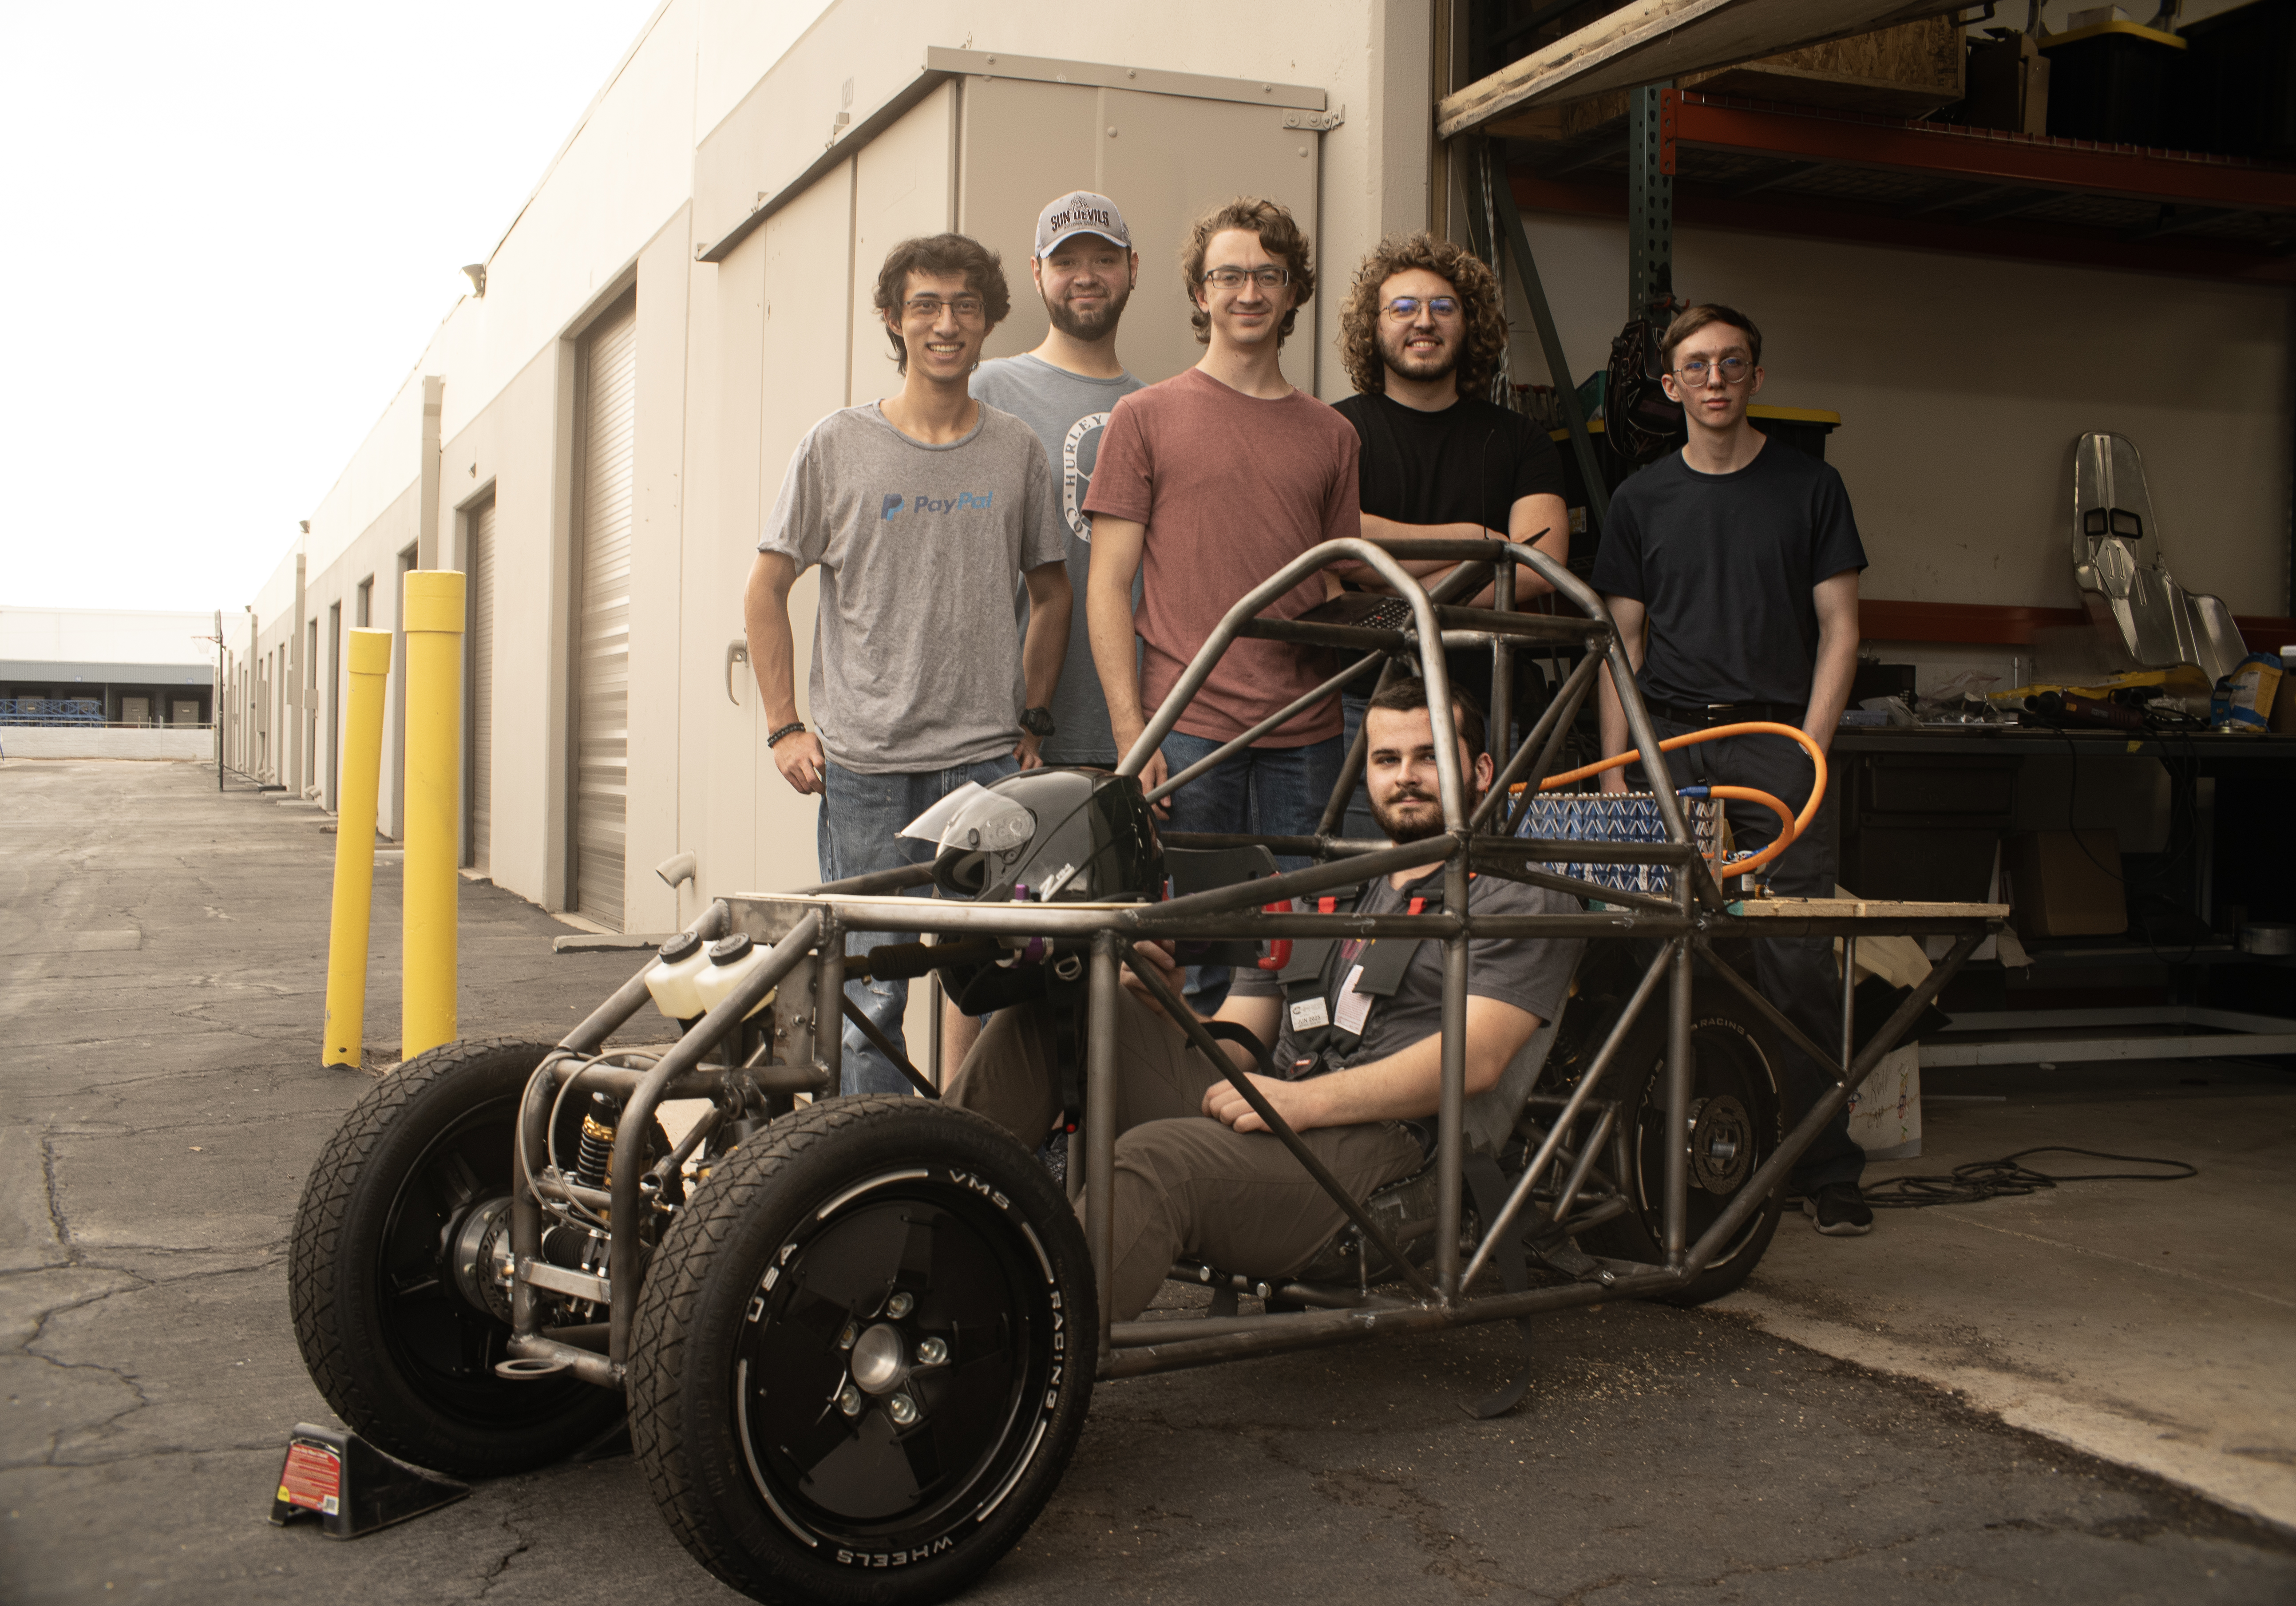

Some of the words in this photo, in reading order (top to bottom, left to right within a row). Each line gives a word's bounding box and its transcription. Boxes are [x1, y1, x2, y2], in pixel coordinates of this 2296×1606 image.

[1051, 210, 1071, 232] SUN
[1073, 208, 1109, 226] DEVILS
[1065, 415, 1101, 486] HURLEY
[914, 491, 993, 514] PayPal
[1700, 1018, 1746, 1036] RACING
[949, 1169, 1009, 1210] VMS
[748, 1243, 798, 1322] USA
[1044, 1291, 1064, 1409] RACING
[837, 1535, 953, 1568] WHEELS
